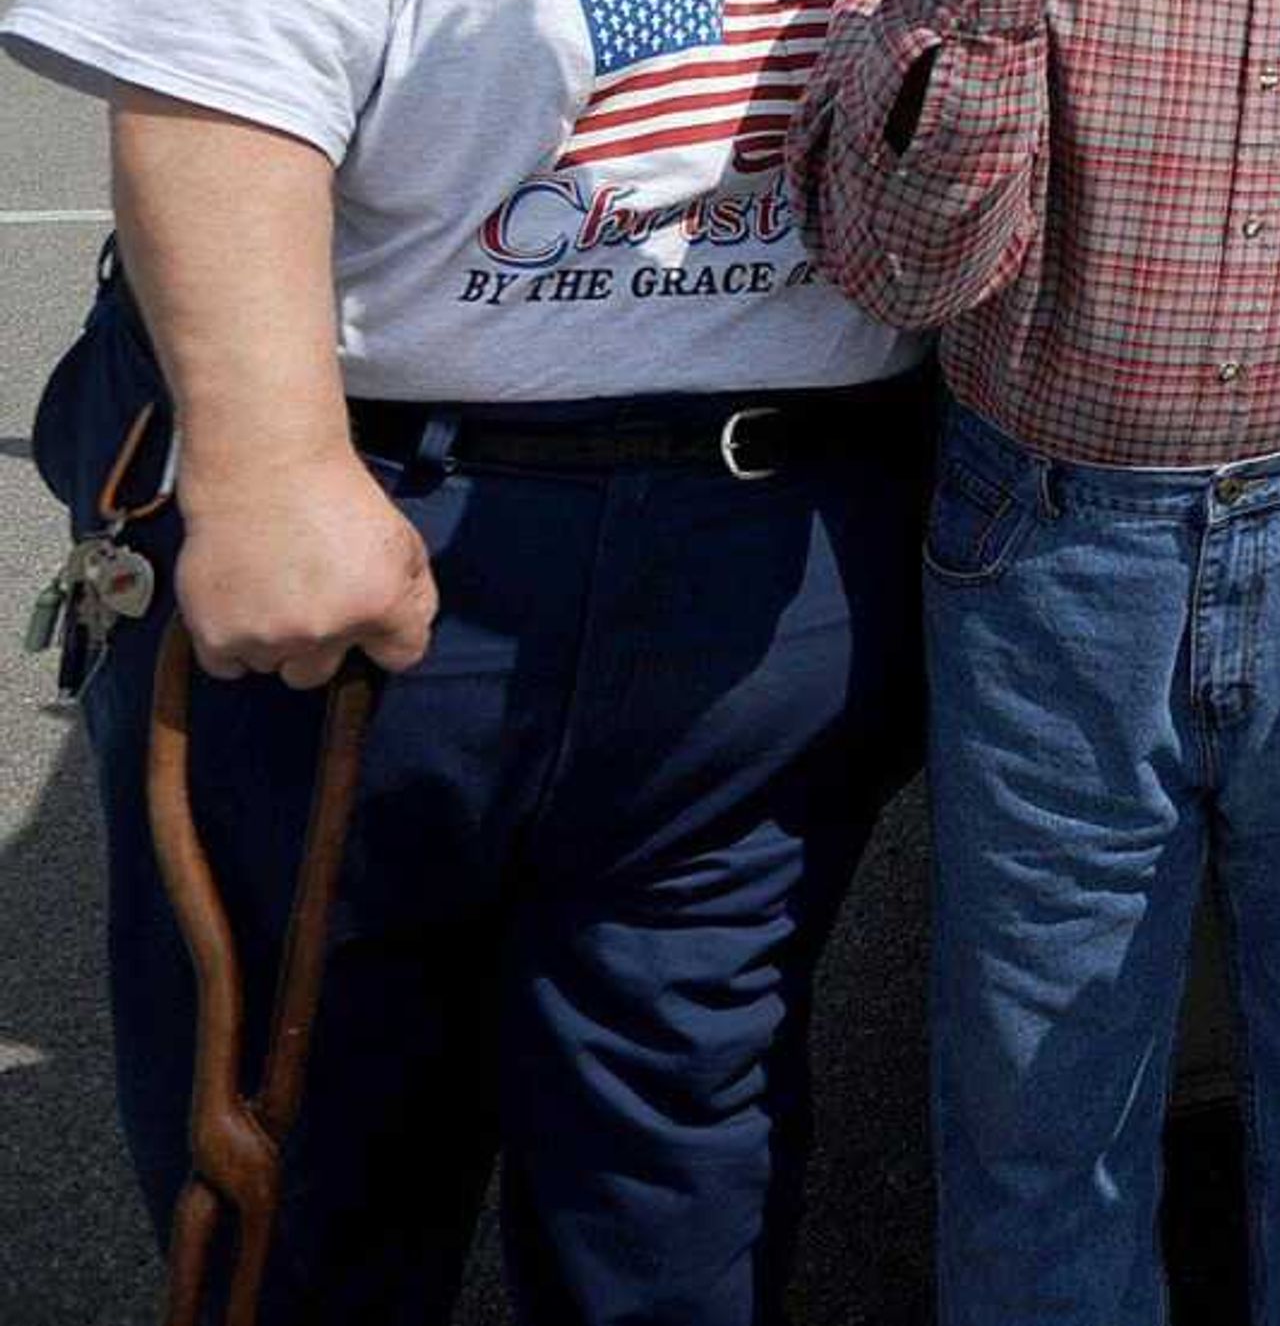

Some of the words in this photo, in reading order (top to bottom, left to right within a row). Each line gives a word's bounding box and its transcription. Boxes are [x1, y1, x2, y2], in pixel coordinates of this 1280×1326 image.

[461, 269, 523, 304] BY
[526, 269, 614, 302] THE
[630, 262, 775, 298] GRACE
